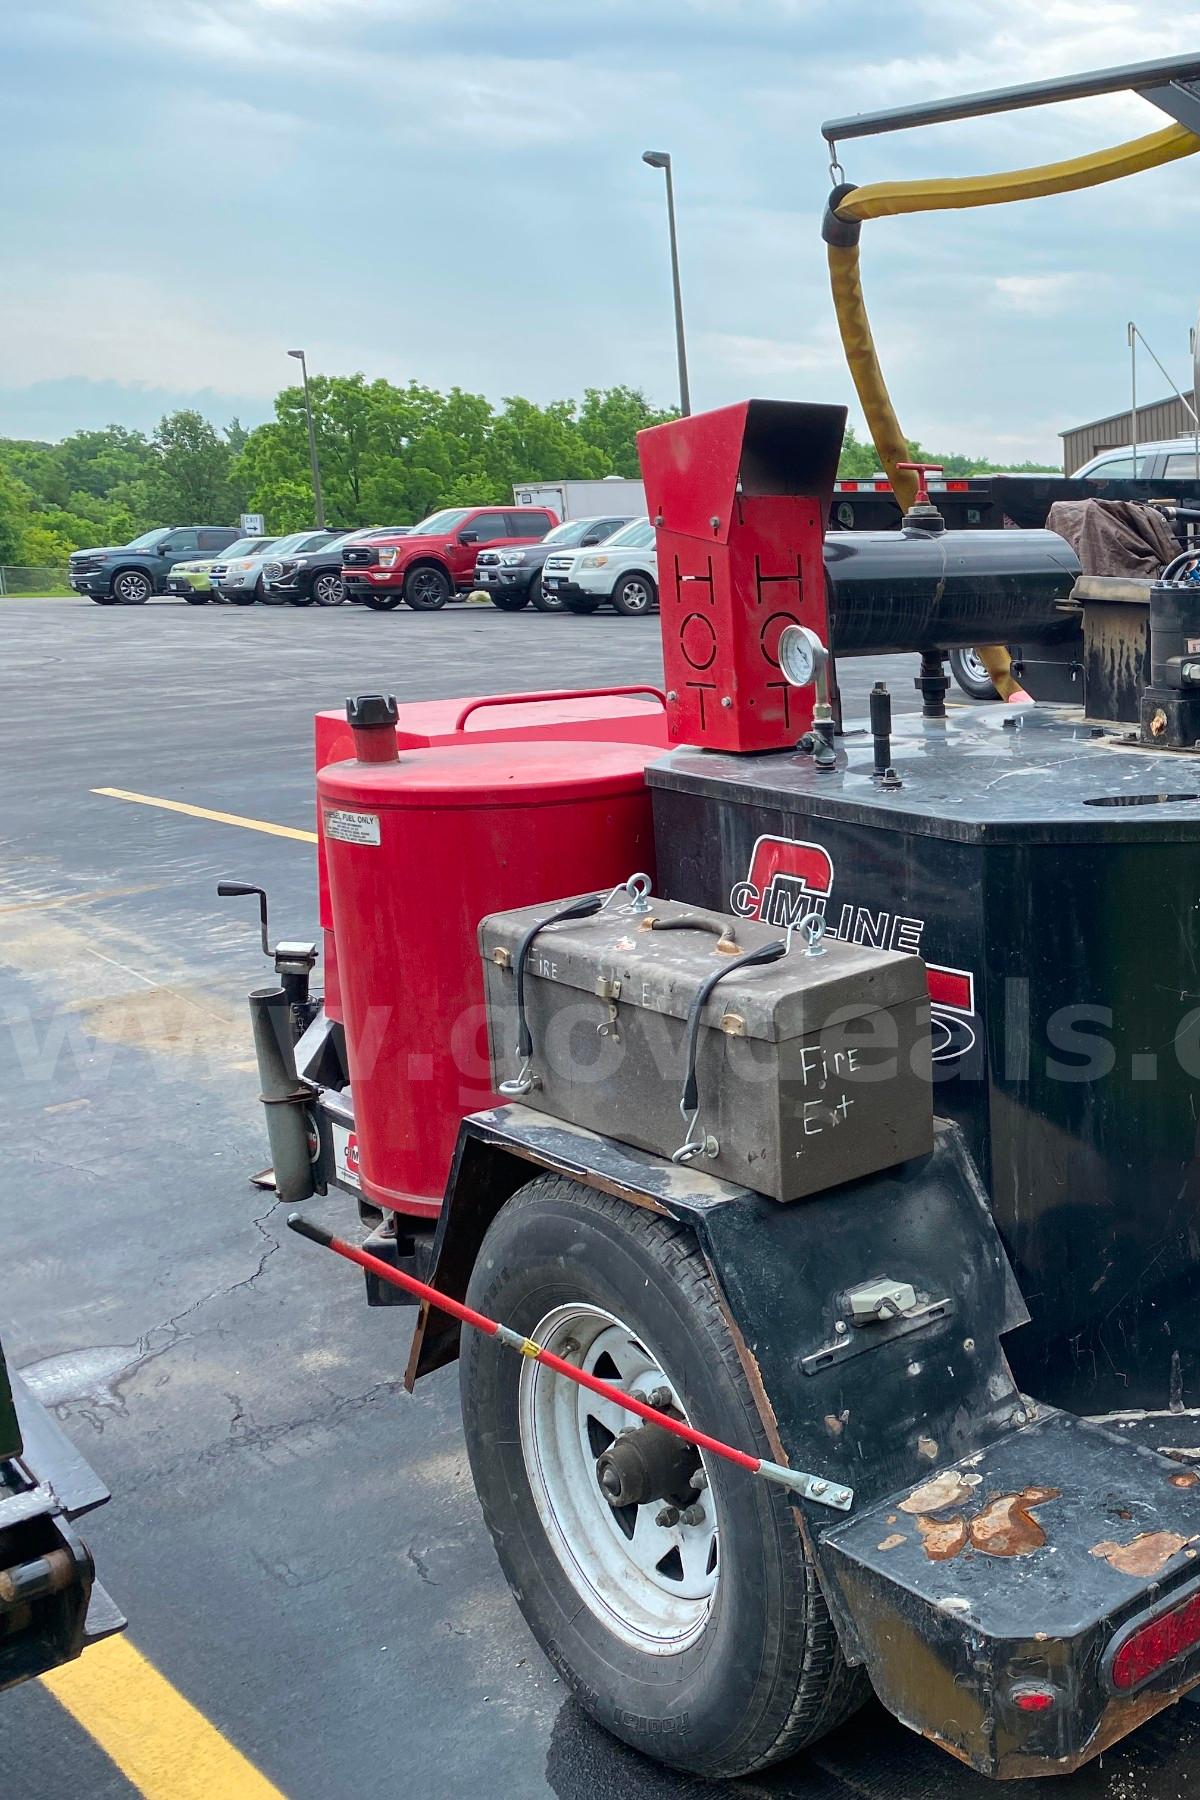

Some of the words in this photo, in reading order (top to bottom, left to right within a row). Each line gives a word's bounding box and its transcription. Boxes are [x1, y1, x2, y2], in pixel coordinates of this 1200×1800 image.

[675, 554, 717, 731] HOT
[755, 553, 803, 729] HOT
[342, 813, 356, 823] FUEL
[357, 815, 374, 825] ONLY
[730, 881, 925, 955] CIMLINE
